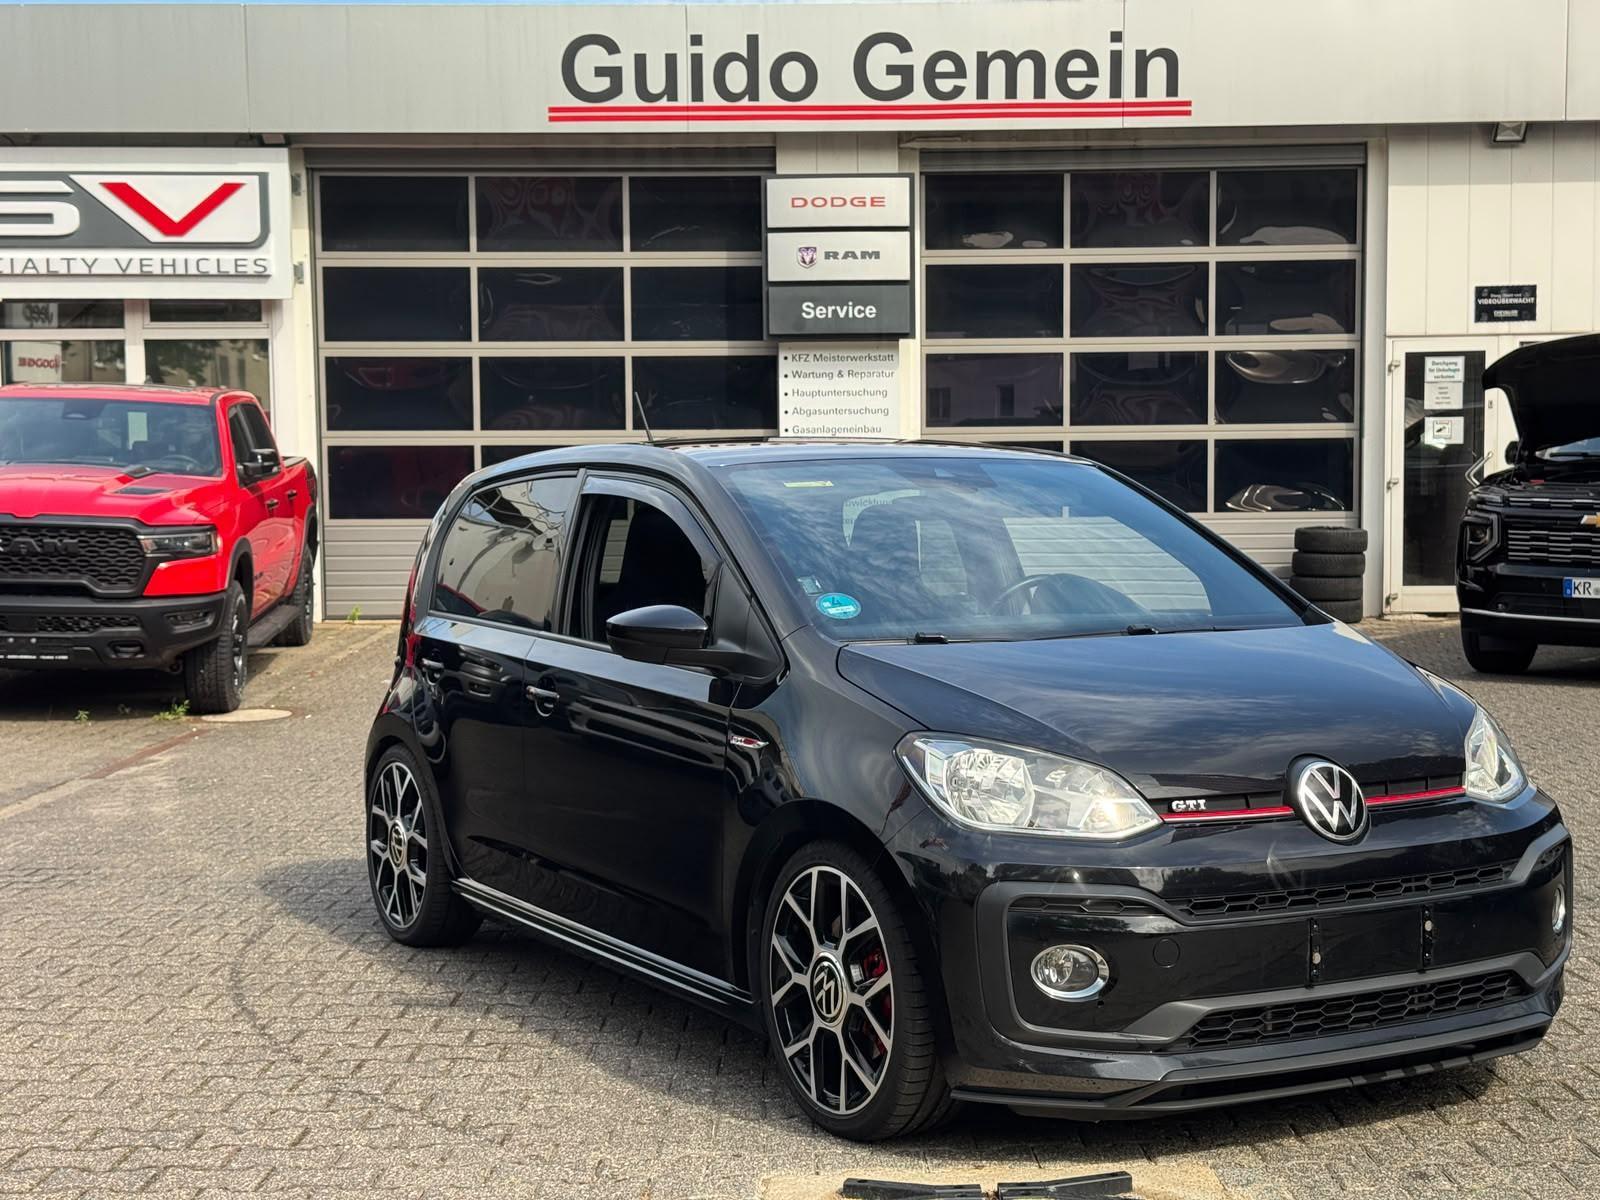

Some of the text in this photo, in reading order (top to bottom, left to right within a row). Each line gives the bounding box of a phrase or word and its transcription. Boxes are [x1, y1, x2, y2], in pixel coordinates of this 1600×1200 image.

[561, 31, 1180, 104] Guido Gemein
[791, 196, 886, 208] DODGE
[824, 250, 881, 260] RAM
[0, 257, 268, 274] IALTY VEHICLES
[801, 302, 877, 319] Service
[791, 353, 895, 363] KFZ Meisterwerkstatt
[791, 369, 895, 381] Wartung & Reparatur
[791, 388, 888, 399] Hauptuntersuchung
[791, 406, 889, 417] Abgasuntersuchung
[792, 425, 882, 436] Gasanlageneinbau
[1573, 581, 1592, 596] KR
[1171, 799, 1207, 812] GTI
